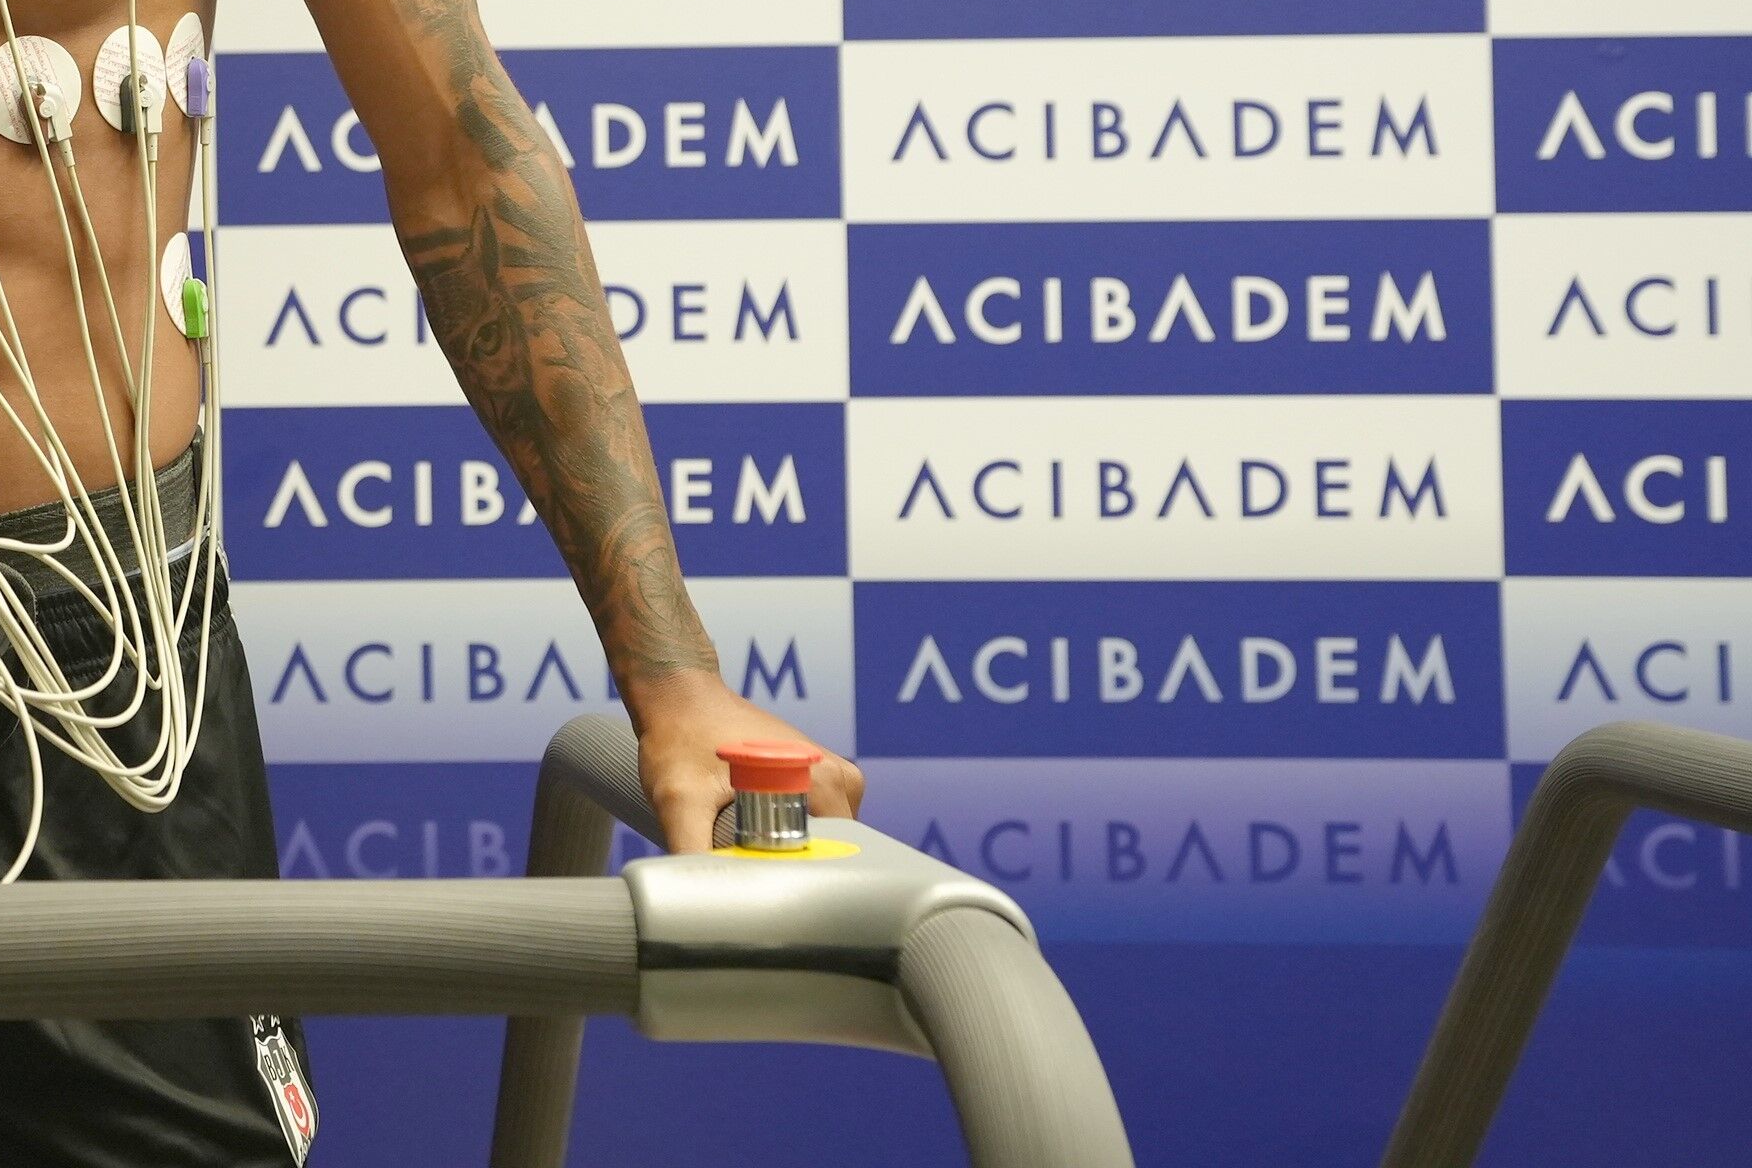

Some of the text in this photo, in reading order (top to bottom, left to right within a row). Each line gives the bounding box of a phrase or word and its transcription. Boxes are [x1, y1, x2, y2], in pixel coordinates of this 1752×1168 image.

[890, 97, 1439, 163] ACIBADEM
[890, 272, 1447, 345] ACIBADEM
[897, 458, 1448, 522] ACIBADEM
[898, 634, 1455, 704] ACIBADEM
[278, 820, 512, 878] ACIB
